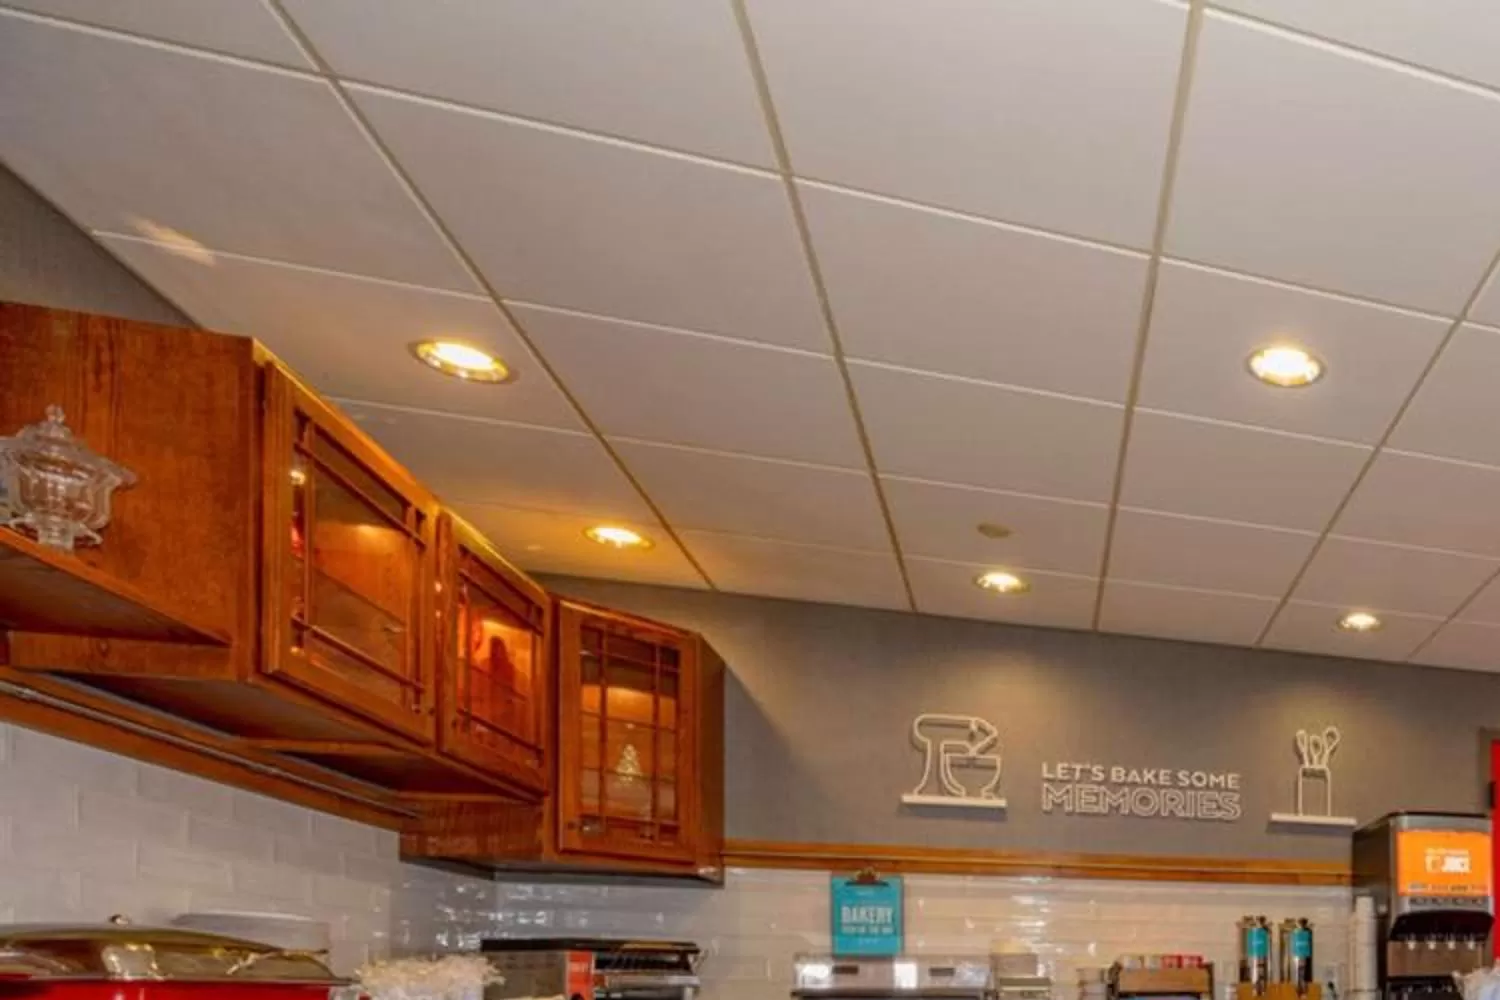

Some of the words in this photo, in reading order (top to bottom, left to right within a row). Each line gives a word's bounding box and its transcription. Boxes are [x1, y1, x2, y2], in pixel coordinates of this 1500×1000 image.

[1041, 762, 1104, 781] LET'S
[1111, 766, 1172, 785] BAKE
[1177, 770, 1240, 789] SOME
[1041, 783, 1242, 820] MEMORIES
